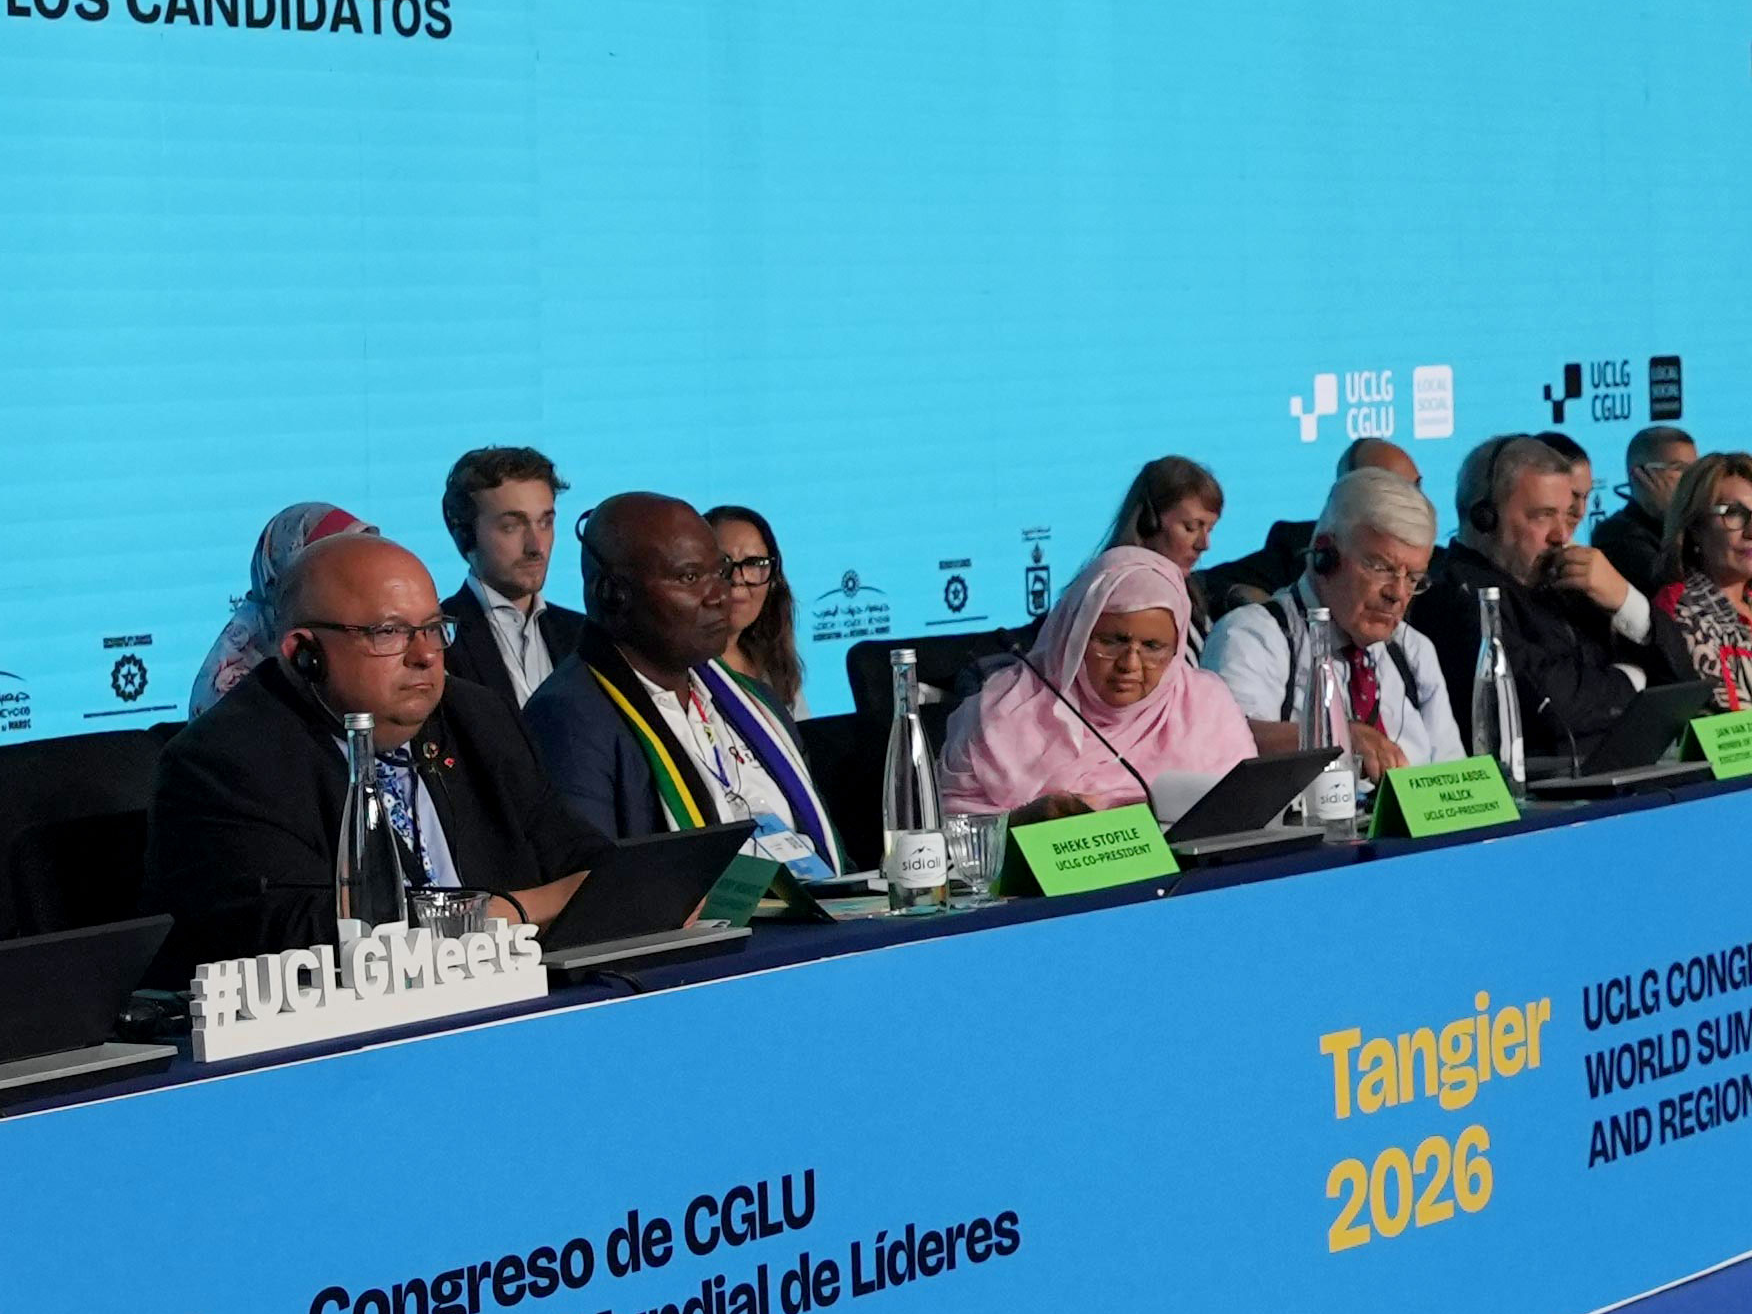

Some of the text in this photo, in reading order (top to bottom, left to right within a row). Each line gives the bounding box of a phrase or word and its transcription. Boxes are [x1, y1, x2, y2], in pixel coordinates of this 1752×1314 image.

[1345, 370, 1394, 403] UCLG
[1590, 359, 1631, 389] UCLG
[1346, 405, 1395, 440] CGLU
[1592, 394, 1631, 421] CGLU
[1409, 769, 1492, 790] FATIMETOU ABDEL
[1439, 788, 1474, 802] MALICK
[1423, 801, 1500, 822] UCLG CO-PRESIDENT
[1052, 827, 1141, 855] BHEKE STOFILE
[1055, 843, 1152, 871] UCLG CO-PRESIDENT
[190, 917, 543, 1028] #UCLGMeets
[1582, 969, 1661, 1032] UCLG
[1319, 989, 1551, 1120] Tangier
[1585, 1029, 1691, 1099] WORLD
[1588, 1107, 1653, 1170] AND
[1325, 1124, 1493, 1254] 2026
[606, 1194, 673, 1275] de
[682, 1167, 819, 1258] CGLU
[850, 1207, 1023, 1300] Líderes
